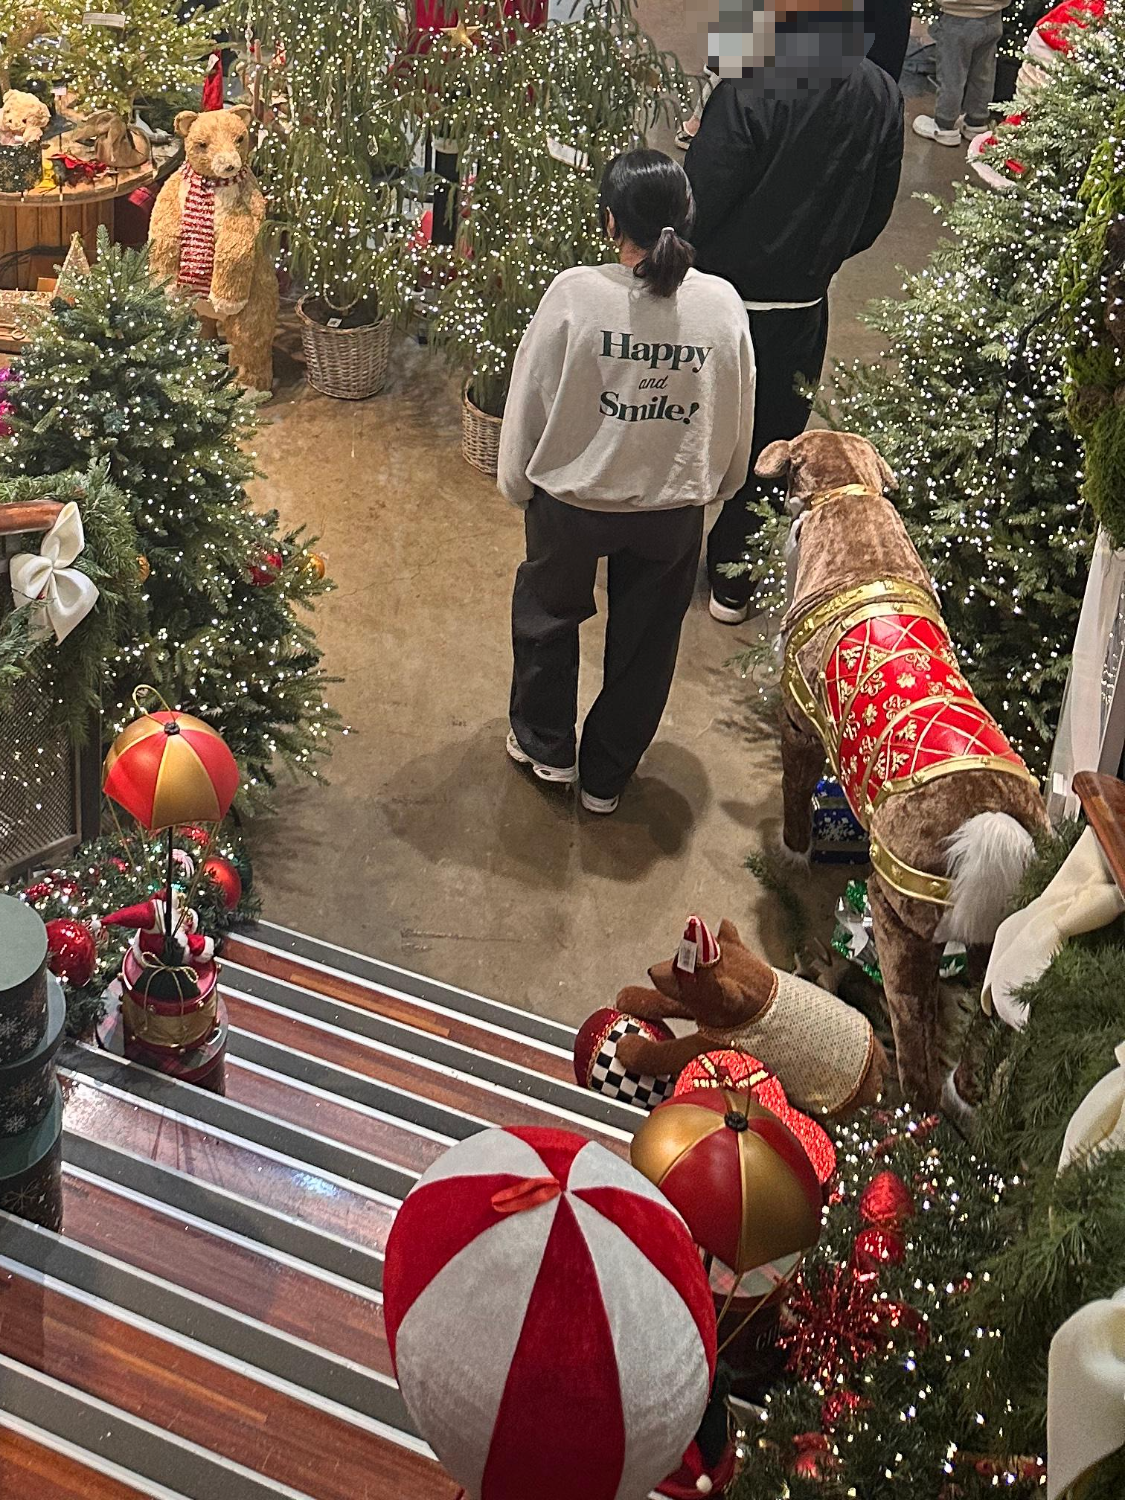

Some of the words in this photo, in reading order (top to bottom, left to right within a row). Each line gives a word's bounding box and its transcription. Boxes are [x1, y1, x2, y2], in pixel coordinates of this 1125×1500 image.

[600, 330, 713, 373] Happy
[638, 375, 669, 390] and
[599, 391, 700, 425] Smile!
